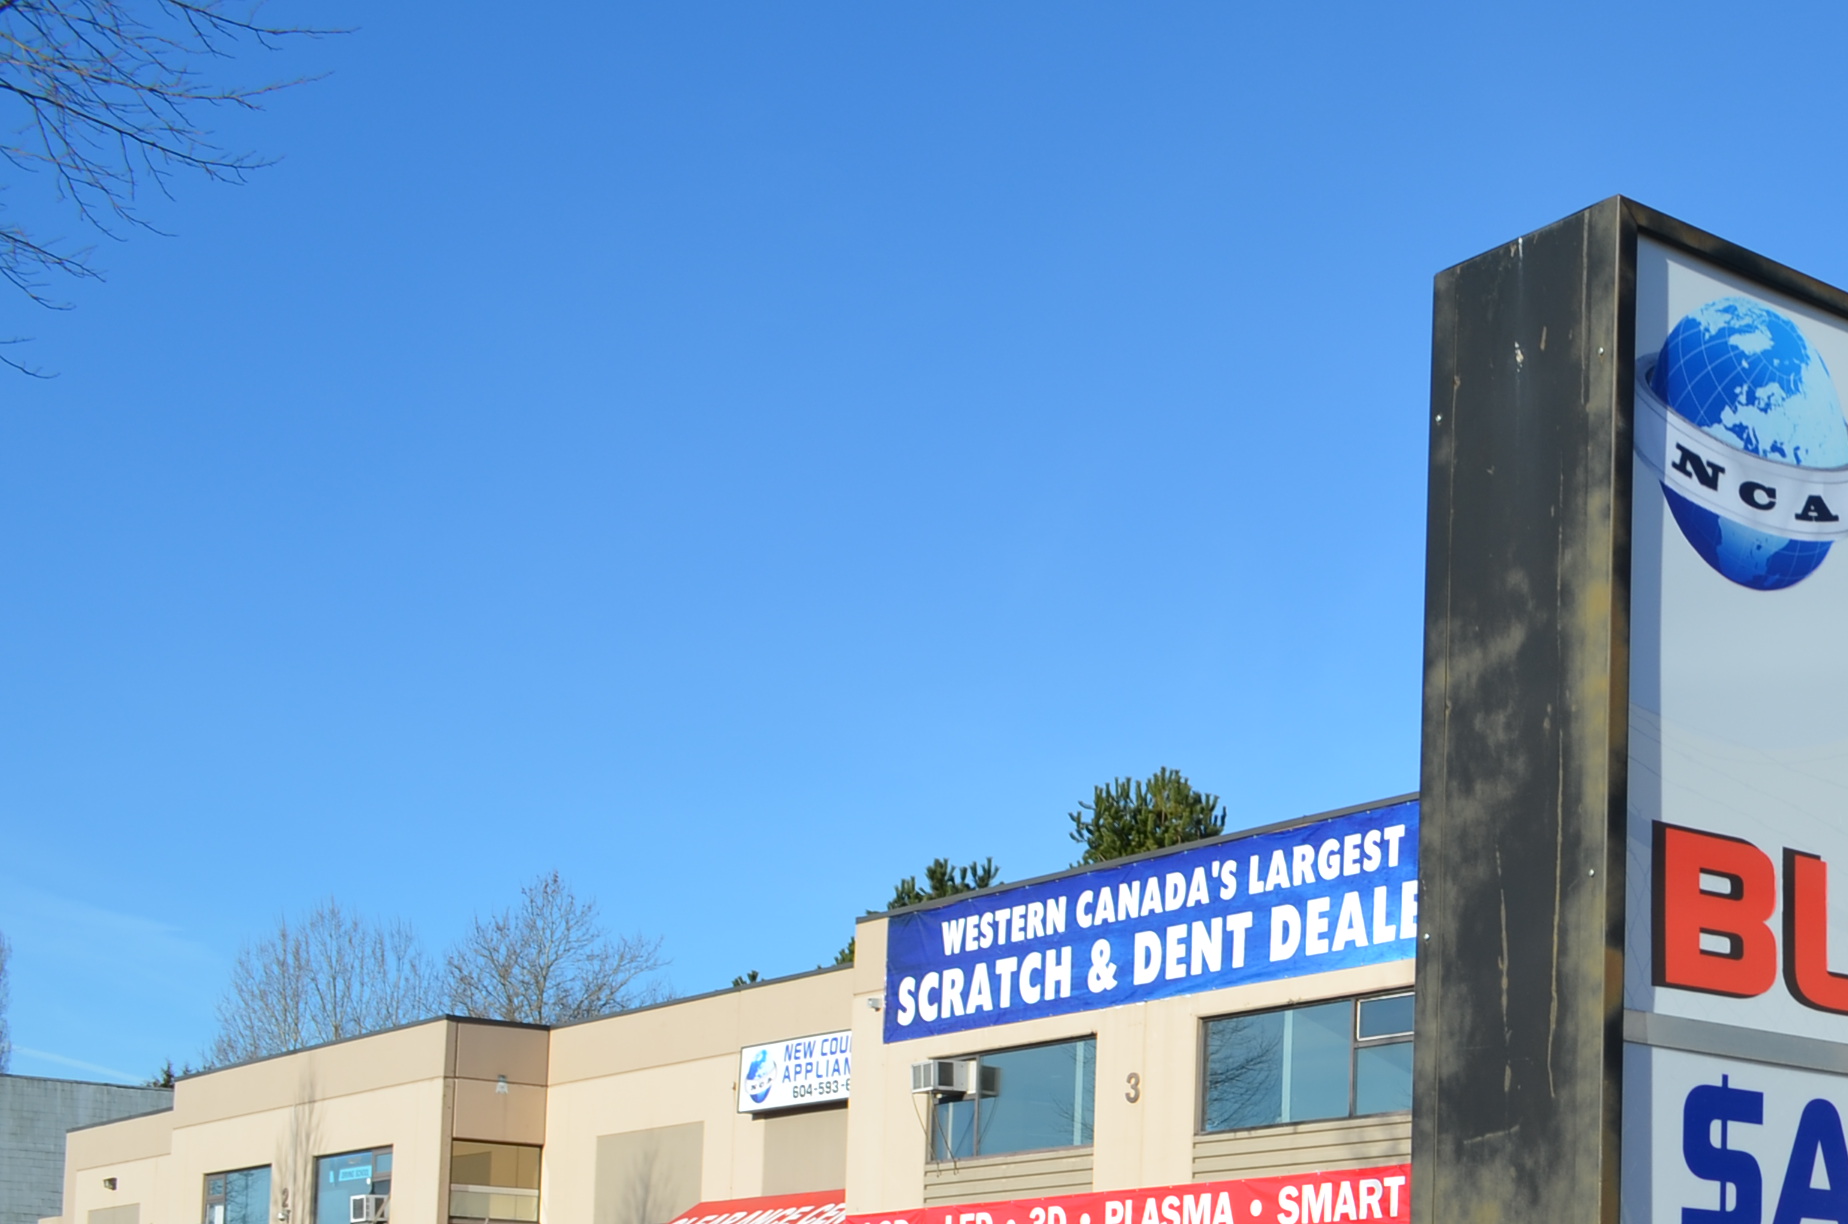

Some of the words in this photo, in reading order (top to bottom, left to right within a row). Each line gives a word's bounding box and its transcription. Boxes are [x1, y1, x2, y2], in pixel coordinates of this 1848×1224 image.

[1671, 442, 1840, 522] NCA
[941, 895, 1067, 957] WESTERN
[1076, 860, 1238, 929] CANADA'S
[1248, 823, 1406, 896] LARGEST
[897, 945, 1073, 1027] SCRATCH
[1087, 938, 1119, 995] &
[1132, 911, 1253, 988] DENT
[1268, 879, 1419, 963] DEALE
[783, 1040, 817, 1063] NEW
[820, 1034, 852, 1057] COU
[1124, 1072, 1141, 1104] 3
[281, 1187, 290, 1209] 2
